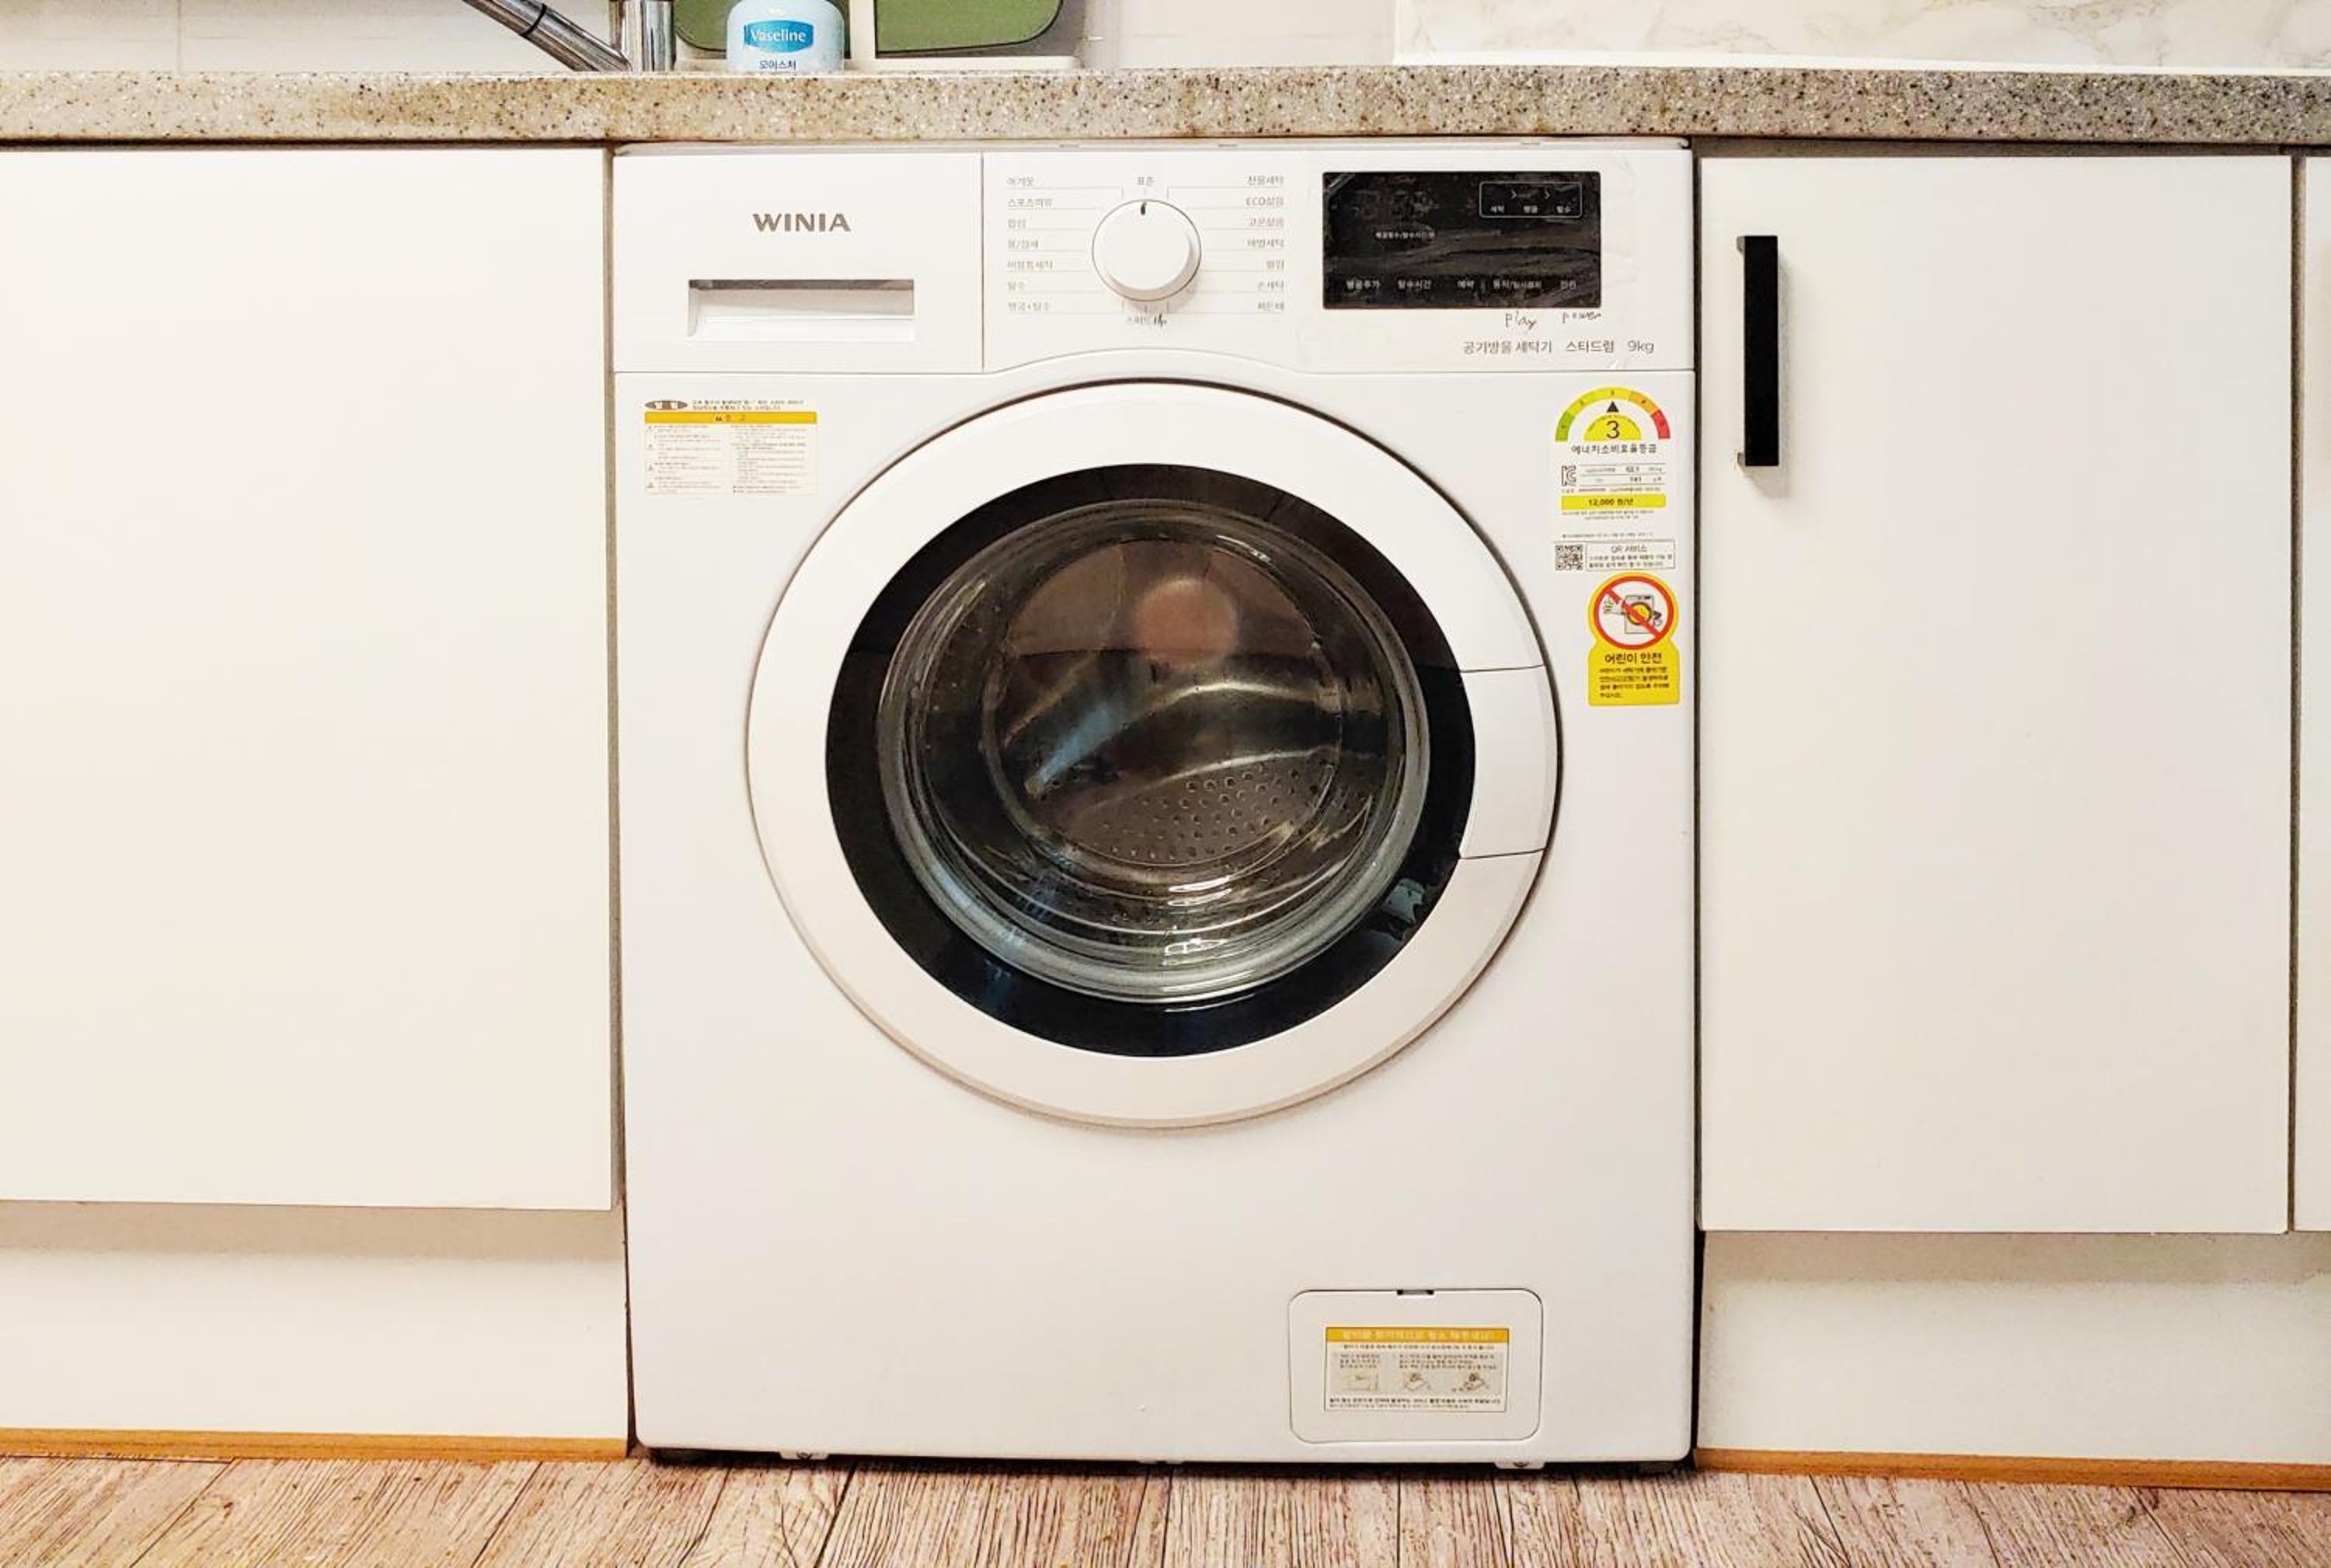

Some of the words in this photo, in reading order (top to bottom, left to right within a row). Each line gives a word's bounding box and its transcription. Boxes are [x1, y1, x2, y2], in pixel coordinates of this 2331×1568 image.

[750, 28, 807, 42] Vaseline
[1137, 176, 1155, 187] 표준
[752, 212, 852, 232] WINIA
[1463, 340, 1512, 355] 공기방울
[1515, 340, 1552, 354] 세탁기
[1566, 340, 1615, 354] 스타드럼
[1628, 340, 1654, 354] 9kg
[1606, 420, 1620, 439] 3
[1605, 653, 1637, 664] 어린이
[1640, 653, 1662, 664] 안전
